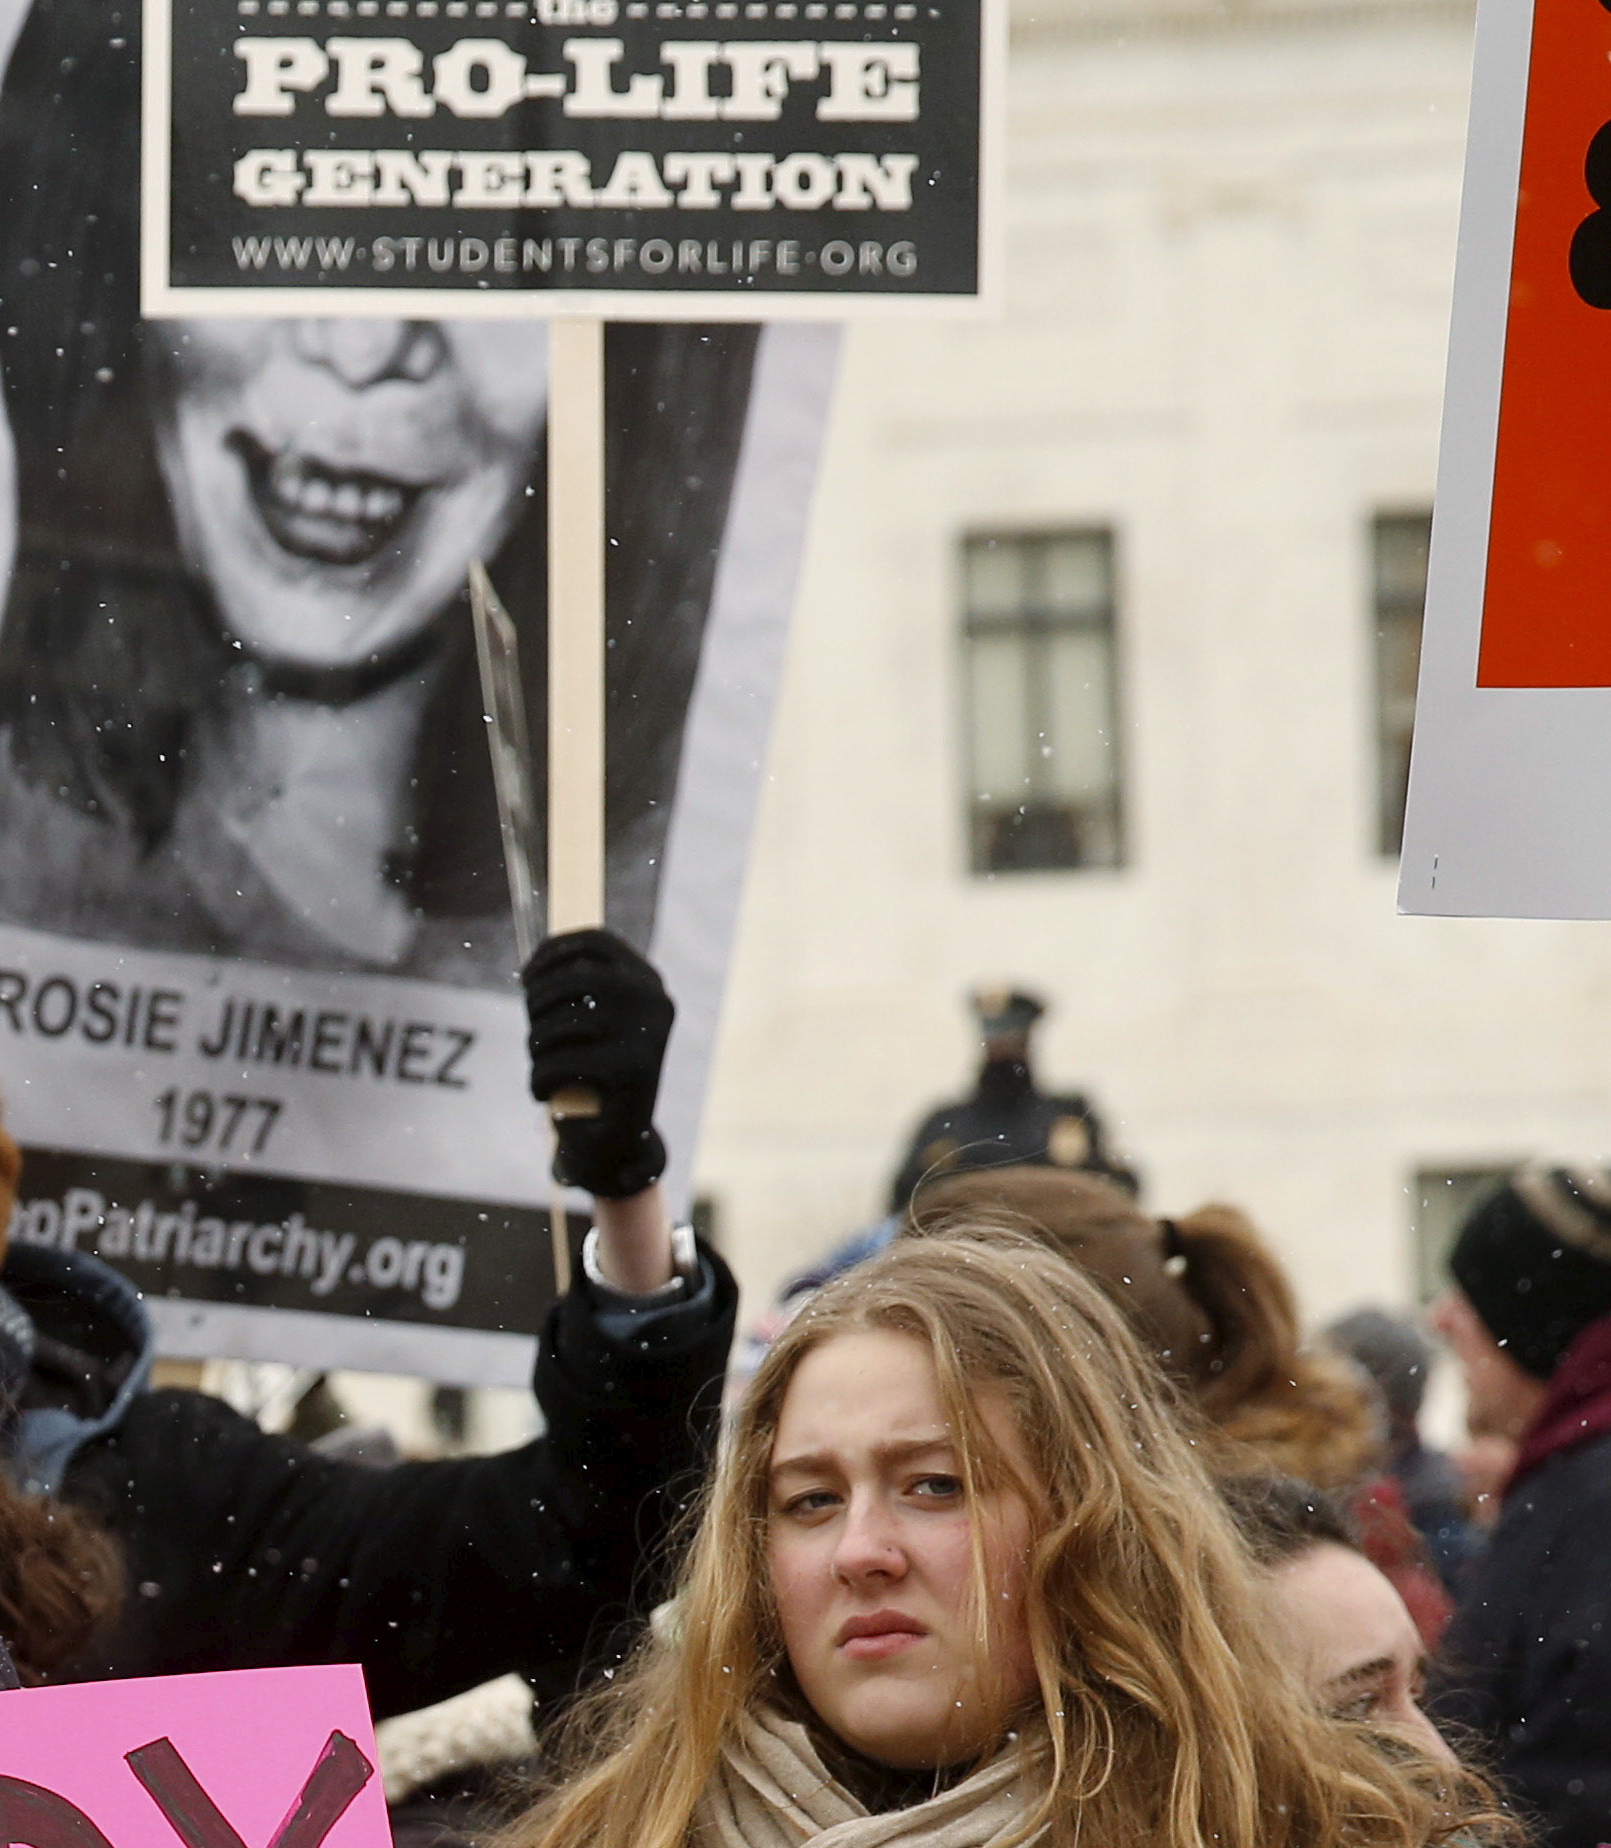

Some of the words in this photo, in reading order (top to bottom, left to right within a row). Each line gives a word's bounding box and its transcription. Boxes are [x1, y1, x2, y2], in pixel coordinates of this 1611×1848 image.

[232, 36, 920, 121] PRO-LIFE
[232, 148, 919, 210] GENERATION
[198, 996, 477, 1091] JIMENEZ
[153, 1087, 285, 1153] 1977
